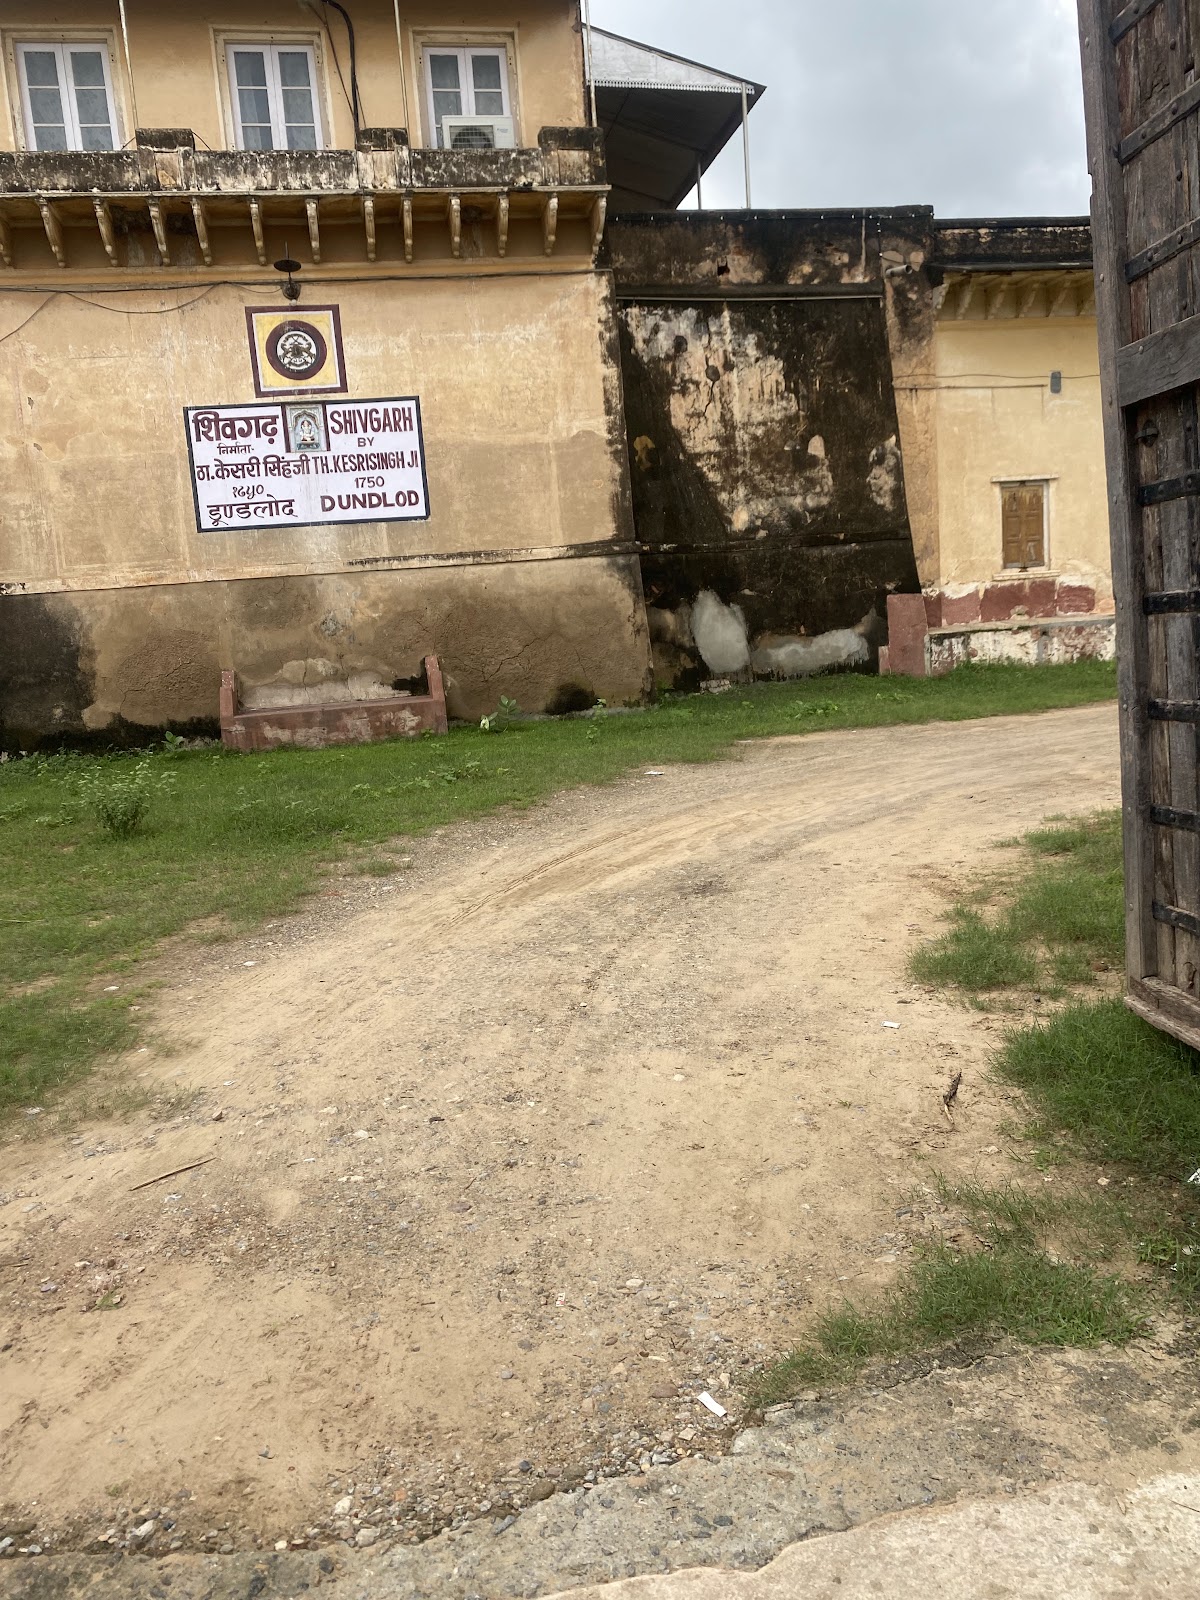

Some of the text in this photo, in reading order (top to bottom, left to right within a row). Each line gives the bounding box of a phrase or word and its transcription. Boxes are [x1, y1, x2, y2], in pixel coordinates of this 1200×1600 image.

[192, 411, 279, 444] शिवगढ़
[330, 407, 413, 435] SHIVGARH
[357, 437, 375, 448] BY
[312, 450, 419, 475] TH.KESRISINGH JI
[354, 475, 385, 488] 1750
[320, 490, 420, 512] DUNDLOD
